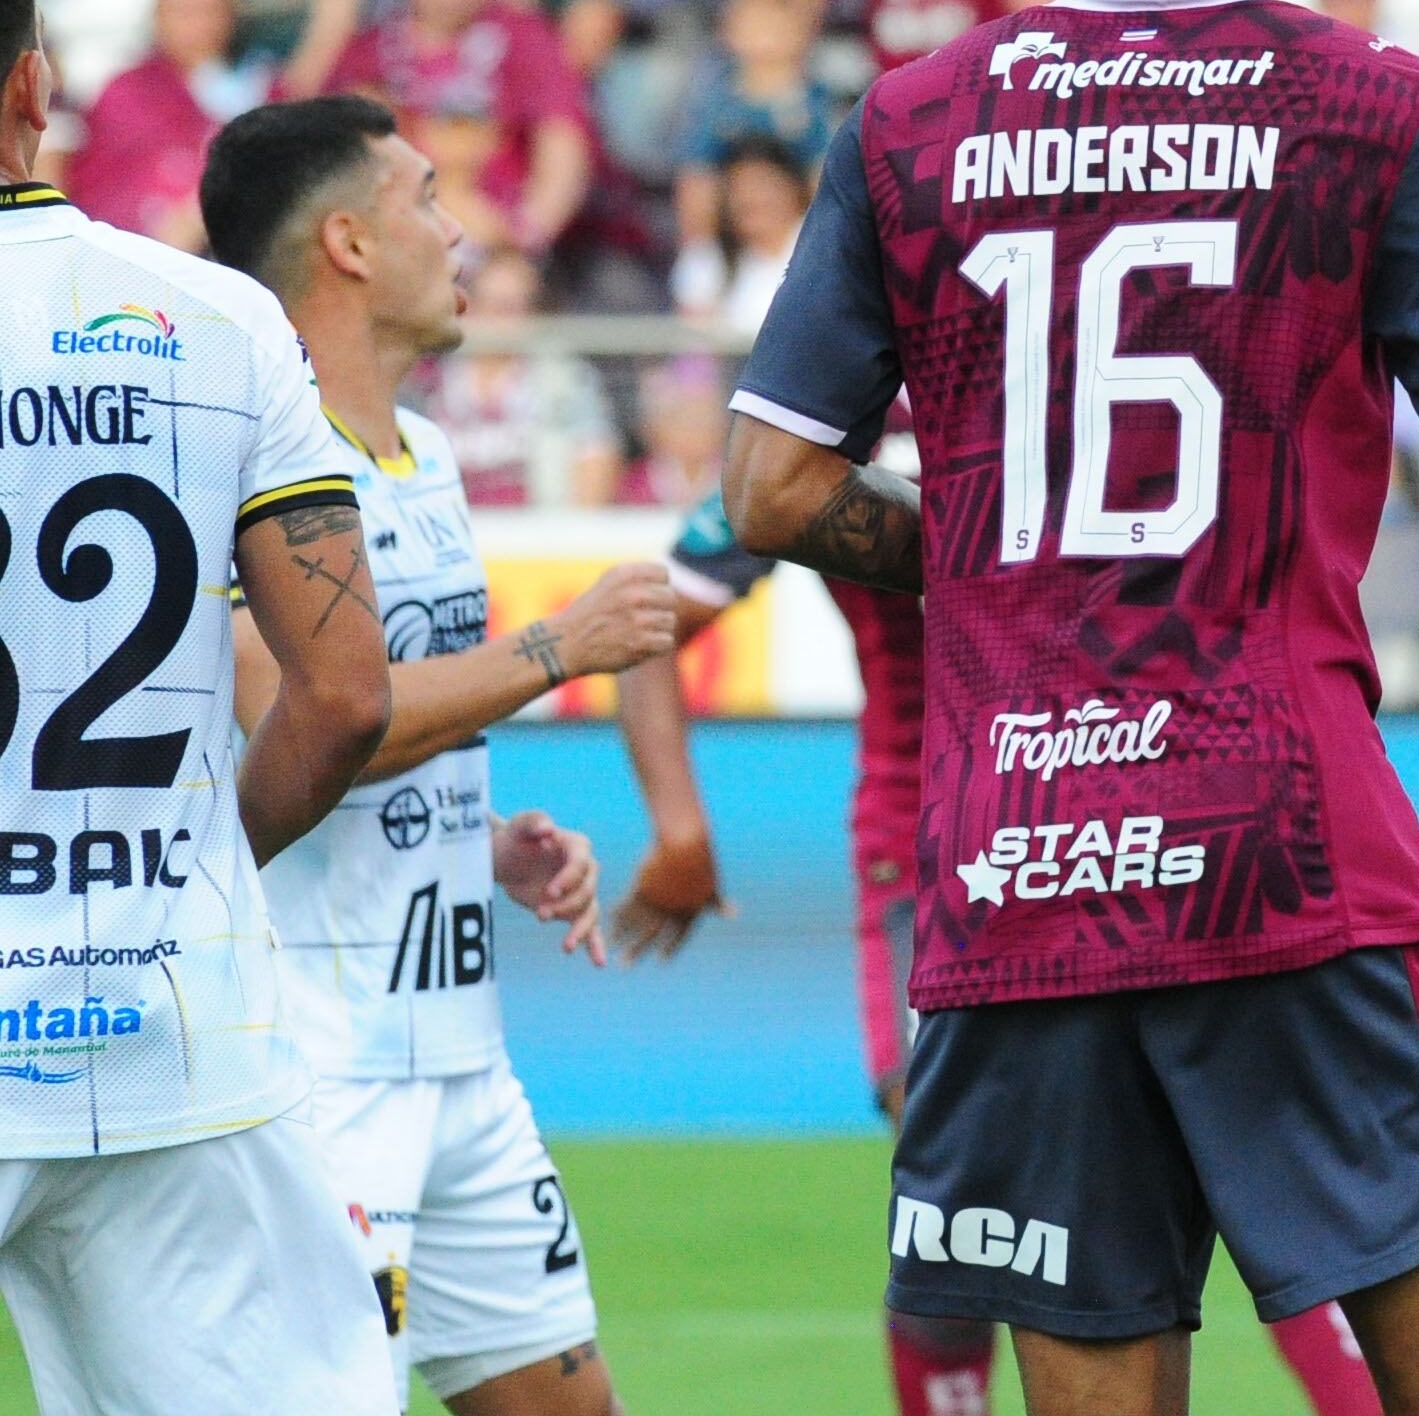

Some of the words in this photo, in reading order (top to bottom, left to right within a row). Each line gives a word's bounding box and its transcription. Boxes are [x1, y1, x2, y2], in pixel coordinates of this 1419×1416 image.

[1028, 50, 1275, 99] medismart
[952, 124, 1280, 204] ANDERSON
[52, 330, 187, 361] Electrolit
[0, 385, 153, 448] ONGE
[957, 218, 1241, 566] 16
[0, 472, 199, 791] 2
[990, 699, 1172, 781] Tropical
[989, 815, 1164, 865] STAR
[1015, 845, 1206, 900] CARS
[890, 1194, 1069, 1287] RCA
